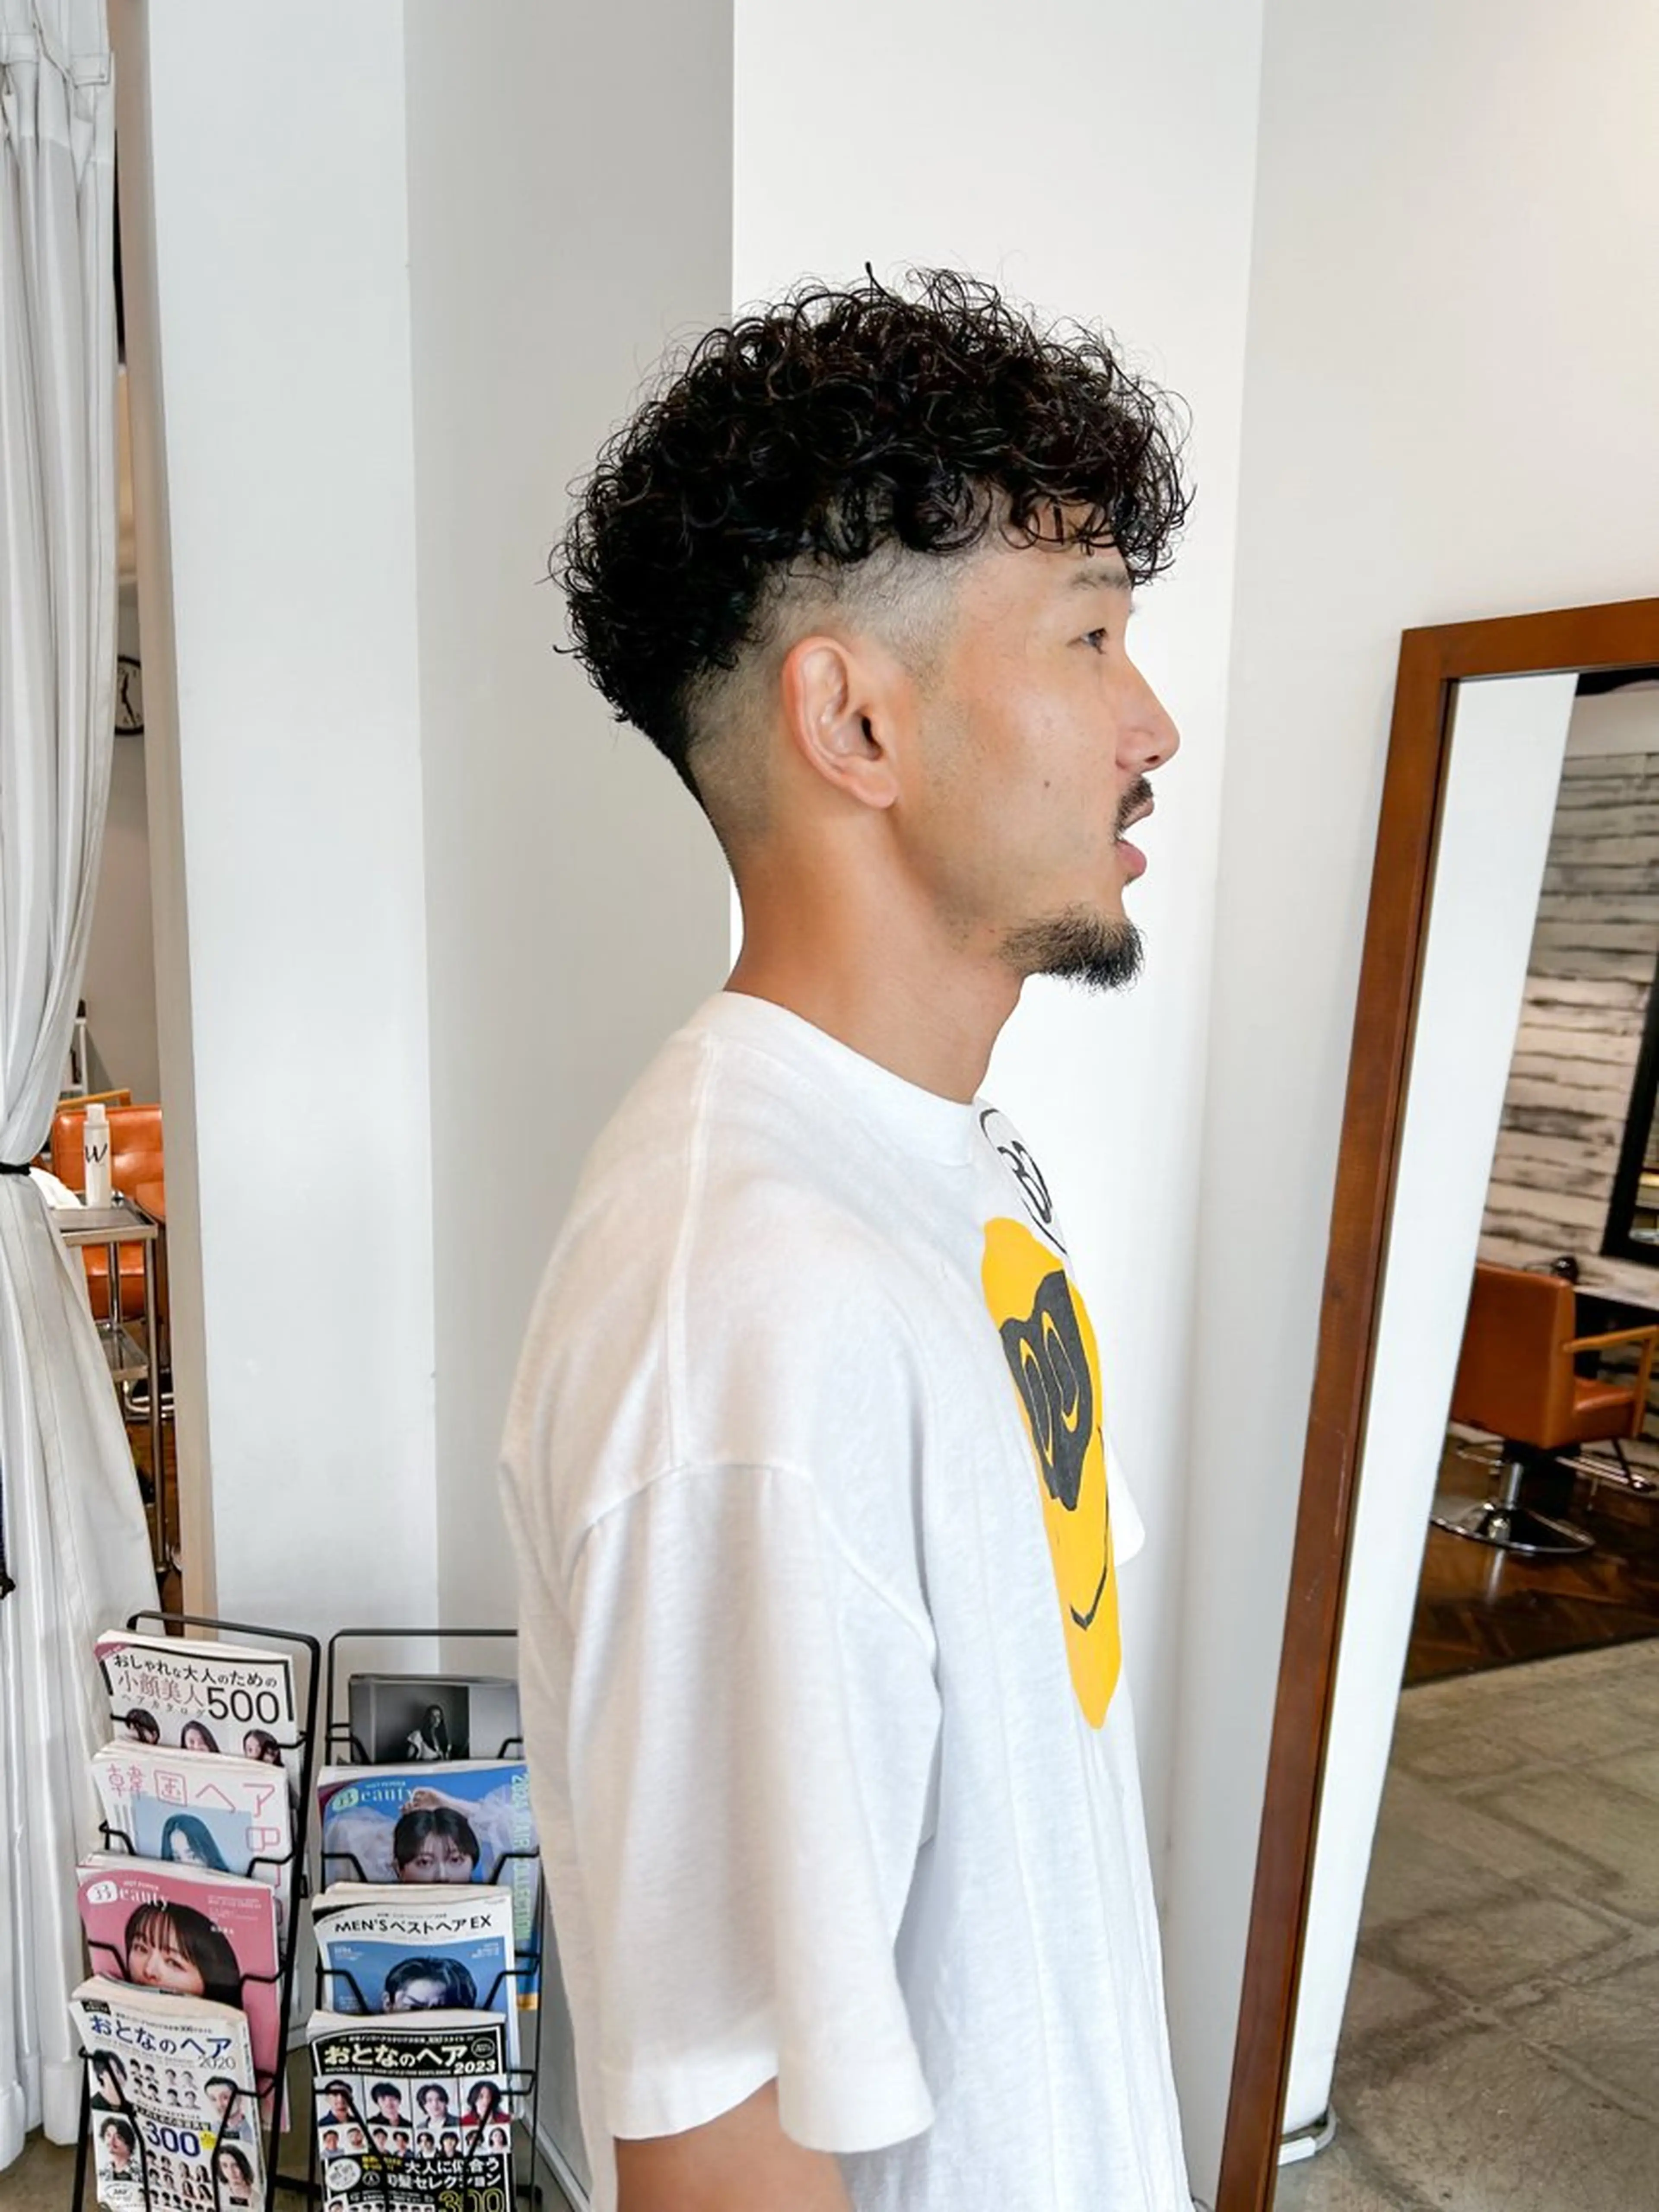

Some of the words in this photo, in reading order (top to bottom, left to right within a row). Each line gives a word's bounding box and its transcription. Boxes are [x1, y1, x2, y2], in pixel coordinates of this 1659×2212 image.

[114, 1654, 277, 1688] おしゃれな大人のための
[207, 1686, 279, 1724] 500
[90, 2015, 232, 2058] おとなのヘア
[198, 2055, 236, 2070] 2020
[324, 2044, 467, 2067] おとなのヘア
[454, 2059, 496, 2074] 2023
[146, 2120, 200, 2157] 300
